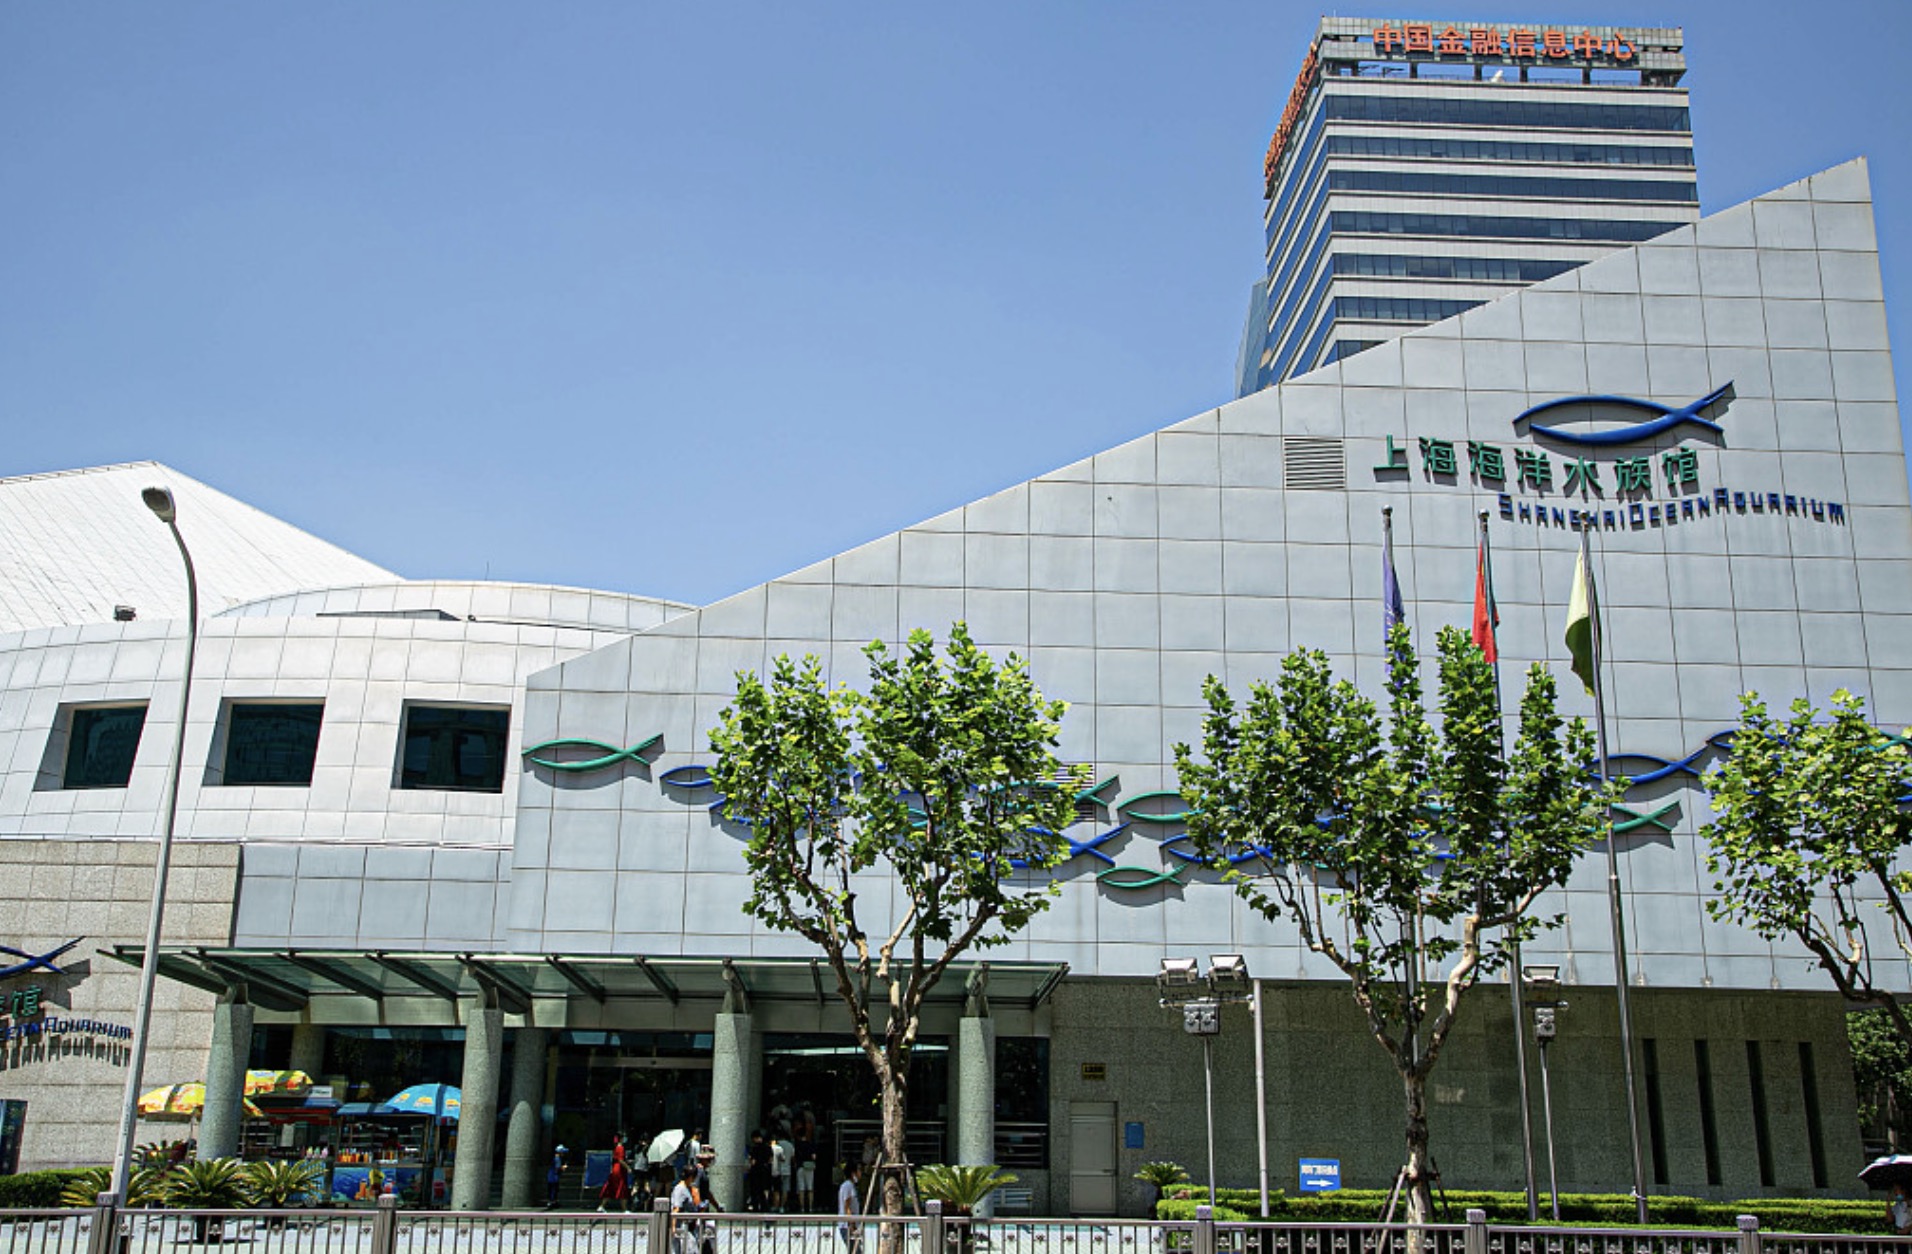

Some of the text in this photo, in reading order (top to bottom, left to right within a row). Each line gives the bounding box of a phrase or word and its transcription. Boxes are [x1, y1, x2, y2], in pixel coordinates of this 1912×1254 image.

[1373, 22, 1636, 60] 中国金融信息中心
[1373, 434, 1698, 492] 上海海洋水族馆
